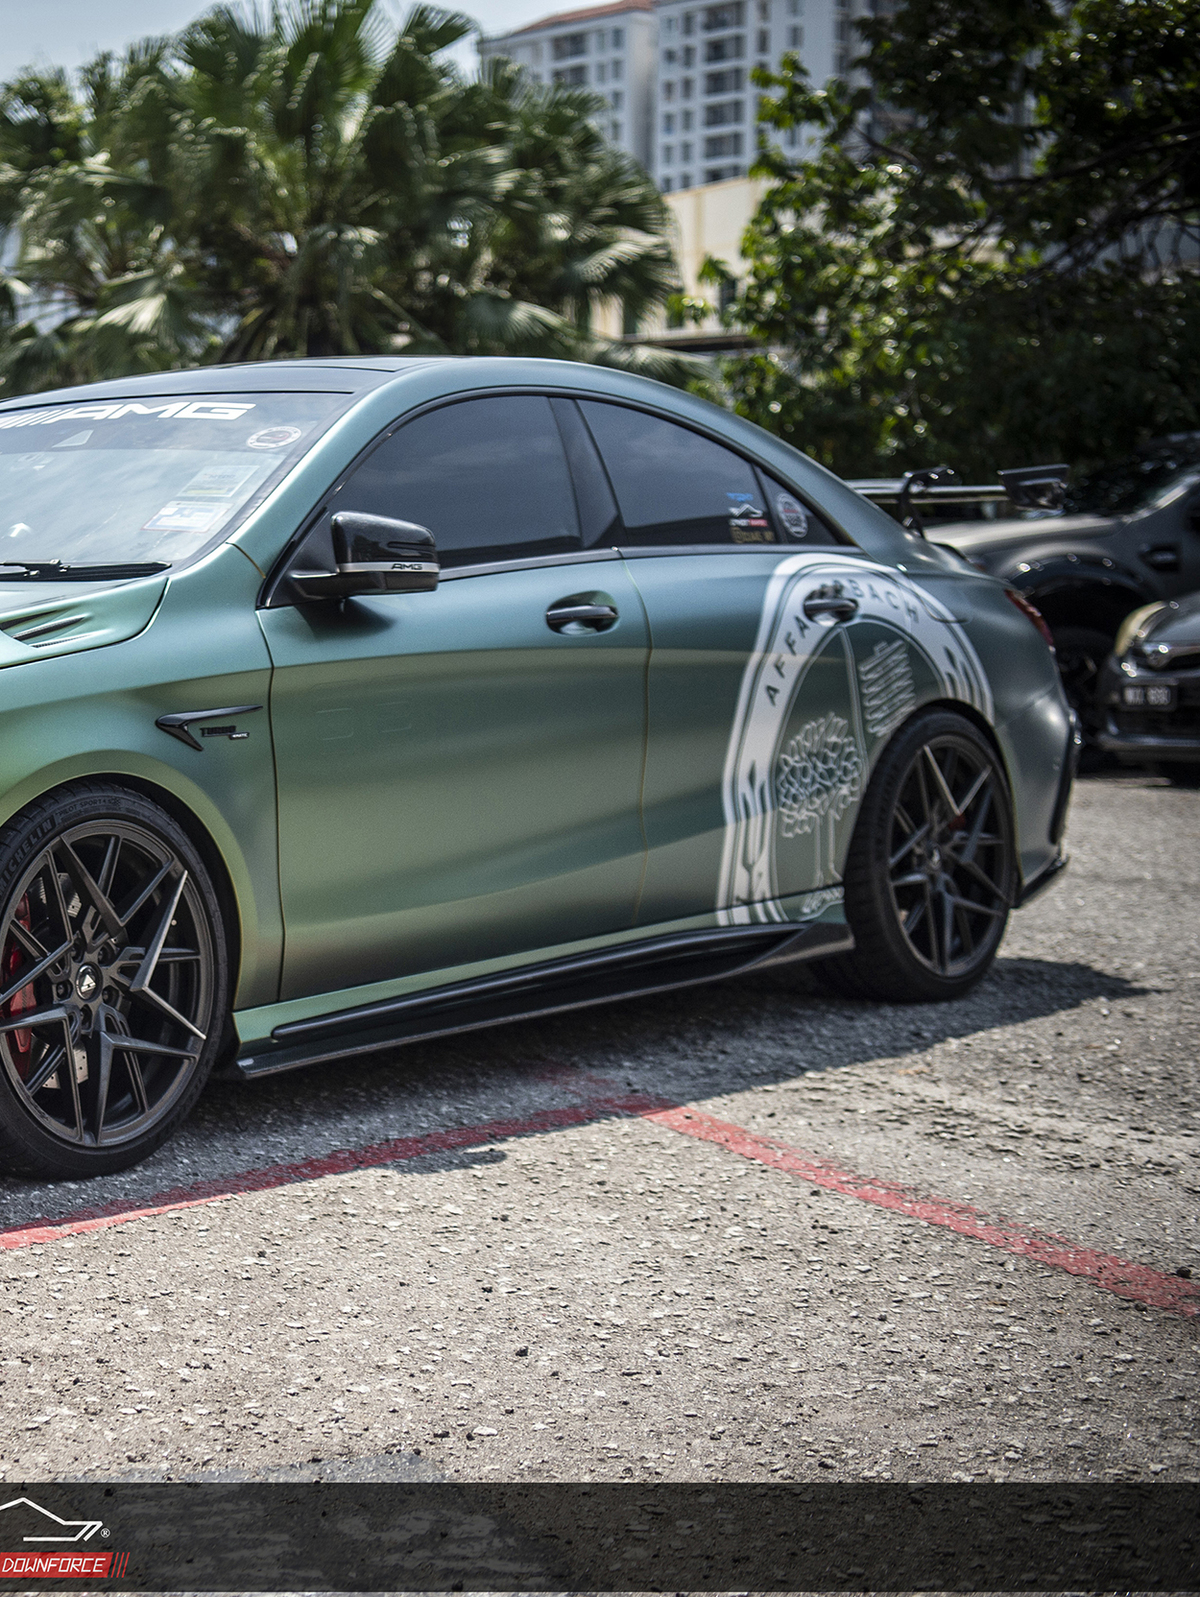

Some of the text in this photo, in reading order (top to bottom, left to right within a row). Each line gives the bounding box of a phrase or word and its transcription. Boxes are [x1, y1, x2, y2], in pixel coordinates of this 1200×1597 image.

[48, 402, 256, 422] AMG
[391, 563, 422, 571] AMG
[765, 579, 919, 706] AFFARBACH
